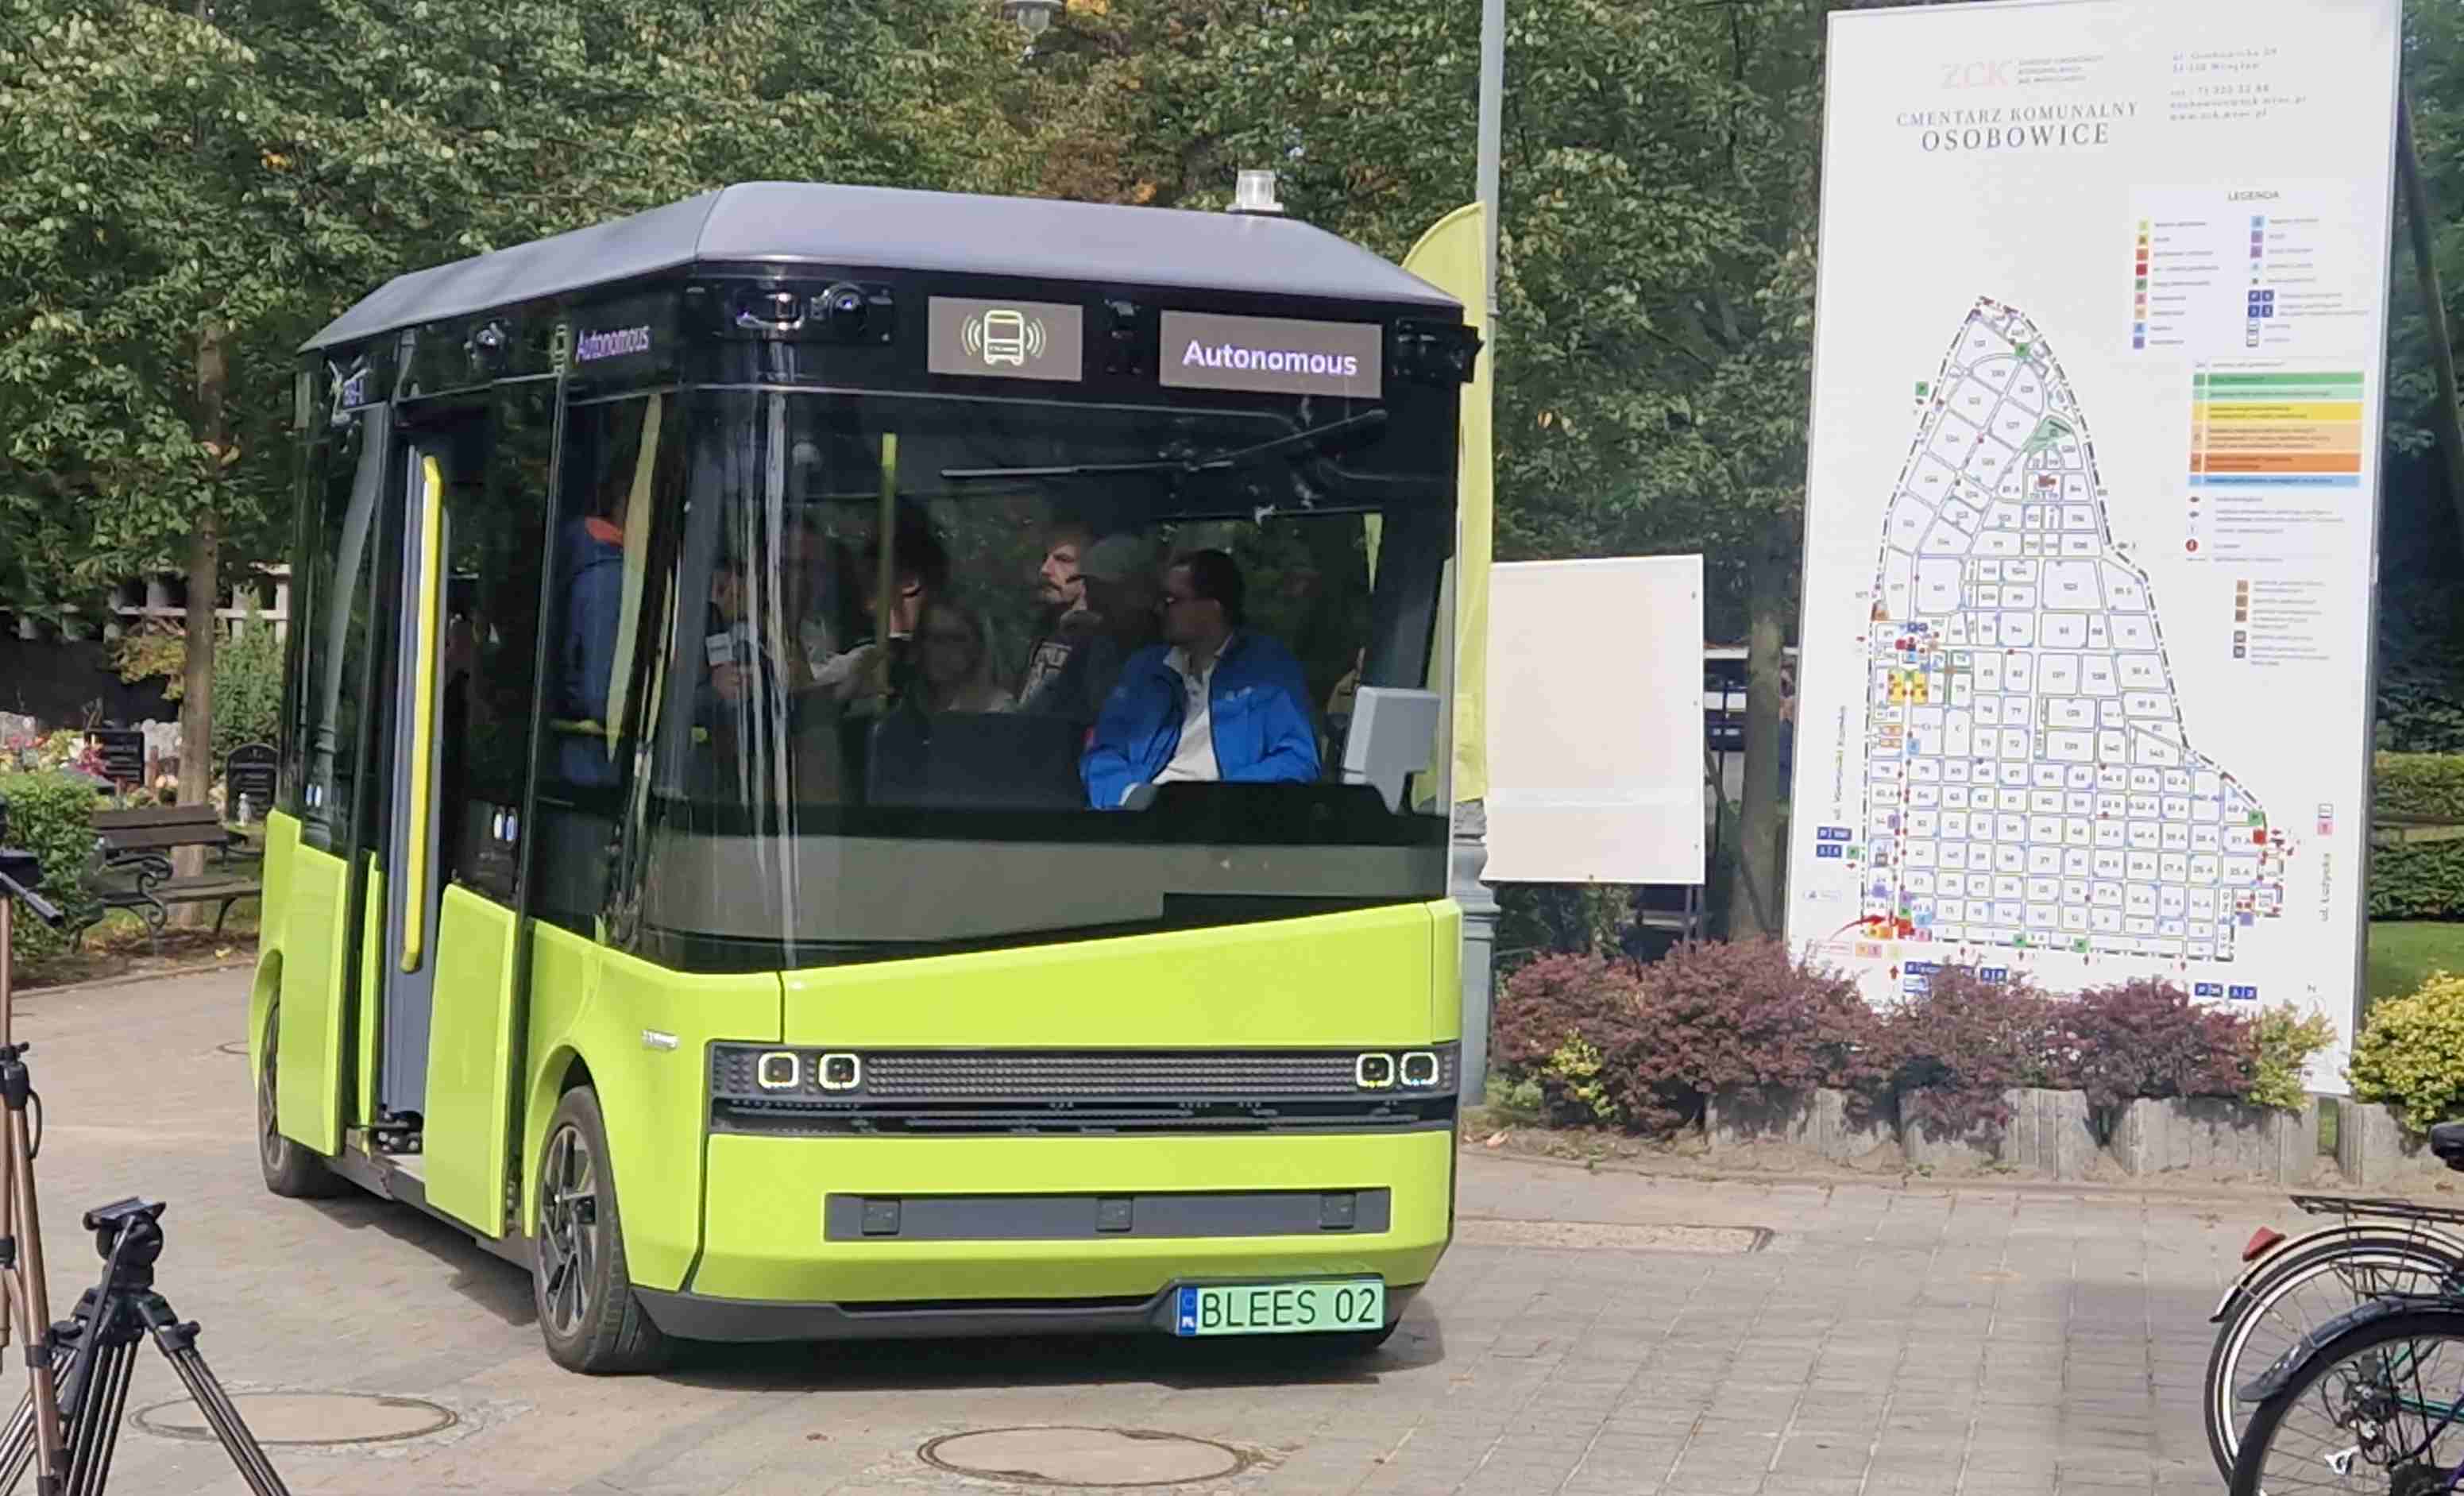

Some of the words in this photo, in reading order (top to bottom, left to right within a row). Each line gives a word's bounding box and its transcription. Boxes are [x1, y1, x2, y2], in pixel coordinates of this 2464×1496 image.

[1898, 108, 2002, 126] CMENTARZ
[2010, 102, 2137, 122] KOMUNALNY
[1922, 122, 2109, 152] OSOBOWICE
[575, 324, 650, 363] Autonomous
[1182, 339, 1358, 376] Autonomous
[1202, 1289, 1316, 1328] BLEES
[1335, 1287, 1376, 1324] 02
